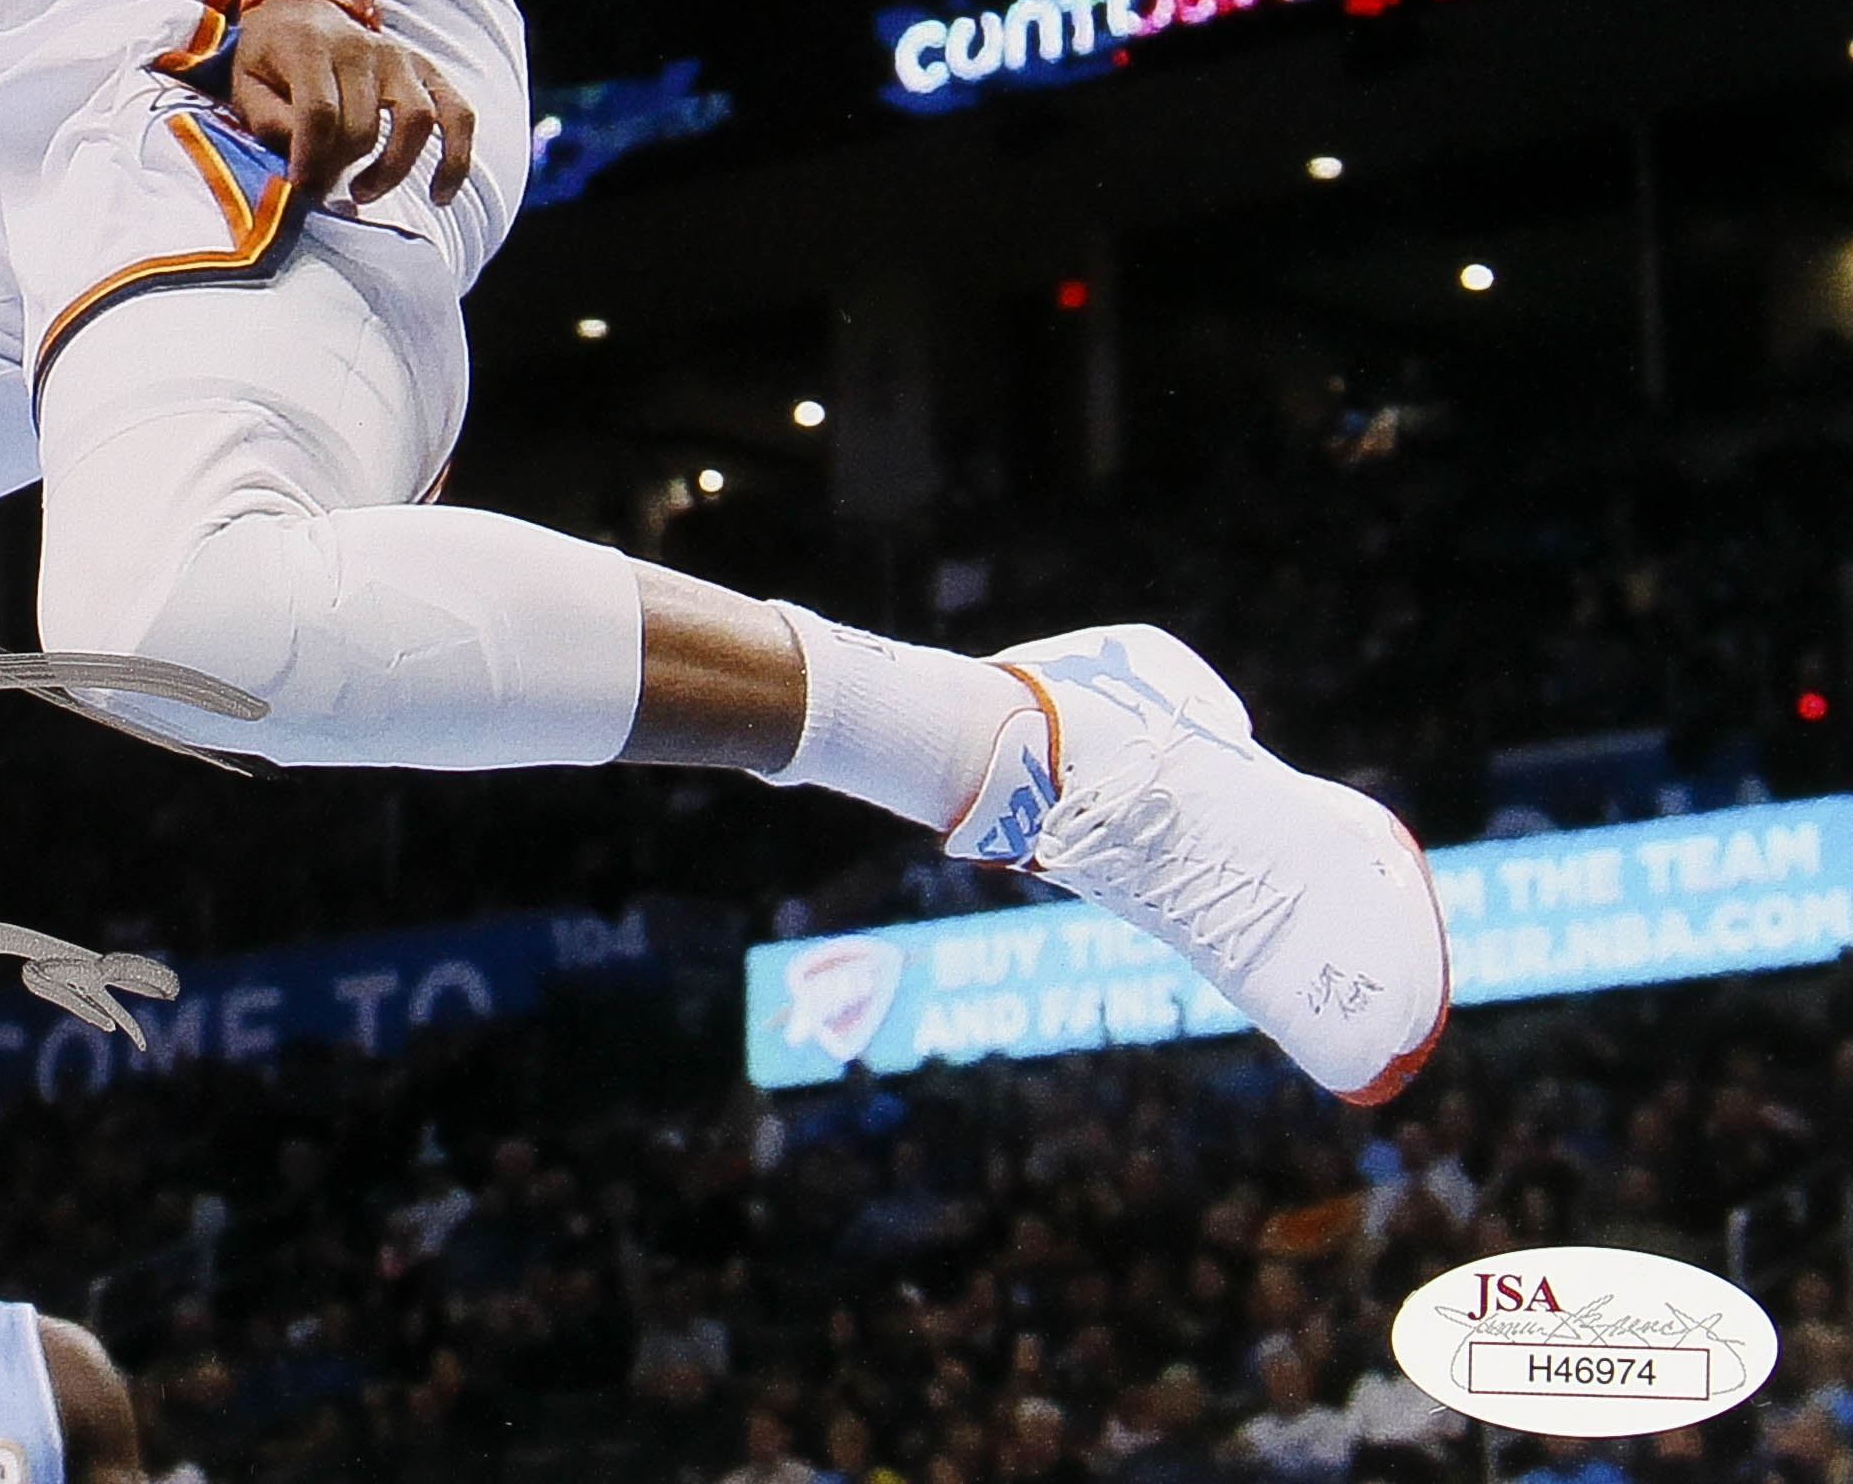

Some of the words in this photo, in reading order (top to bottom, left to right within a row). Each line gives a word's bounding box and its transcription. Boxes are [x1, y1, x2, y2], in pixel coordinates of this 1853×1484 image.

[1638, 822, 1822, 895] TEAM
[1468, 1272, 1564, 1321] JSA
[1528, 1354, 1657, 1386] H46974
